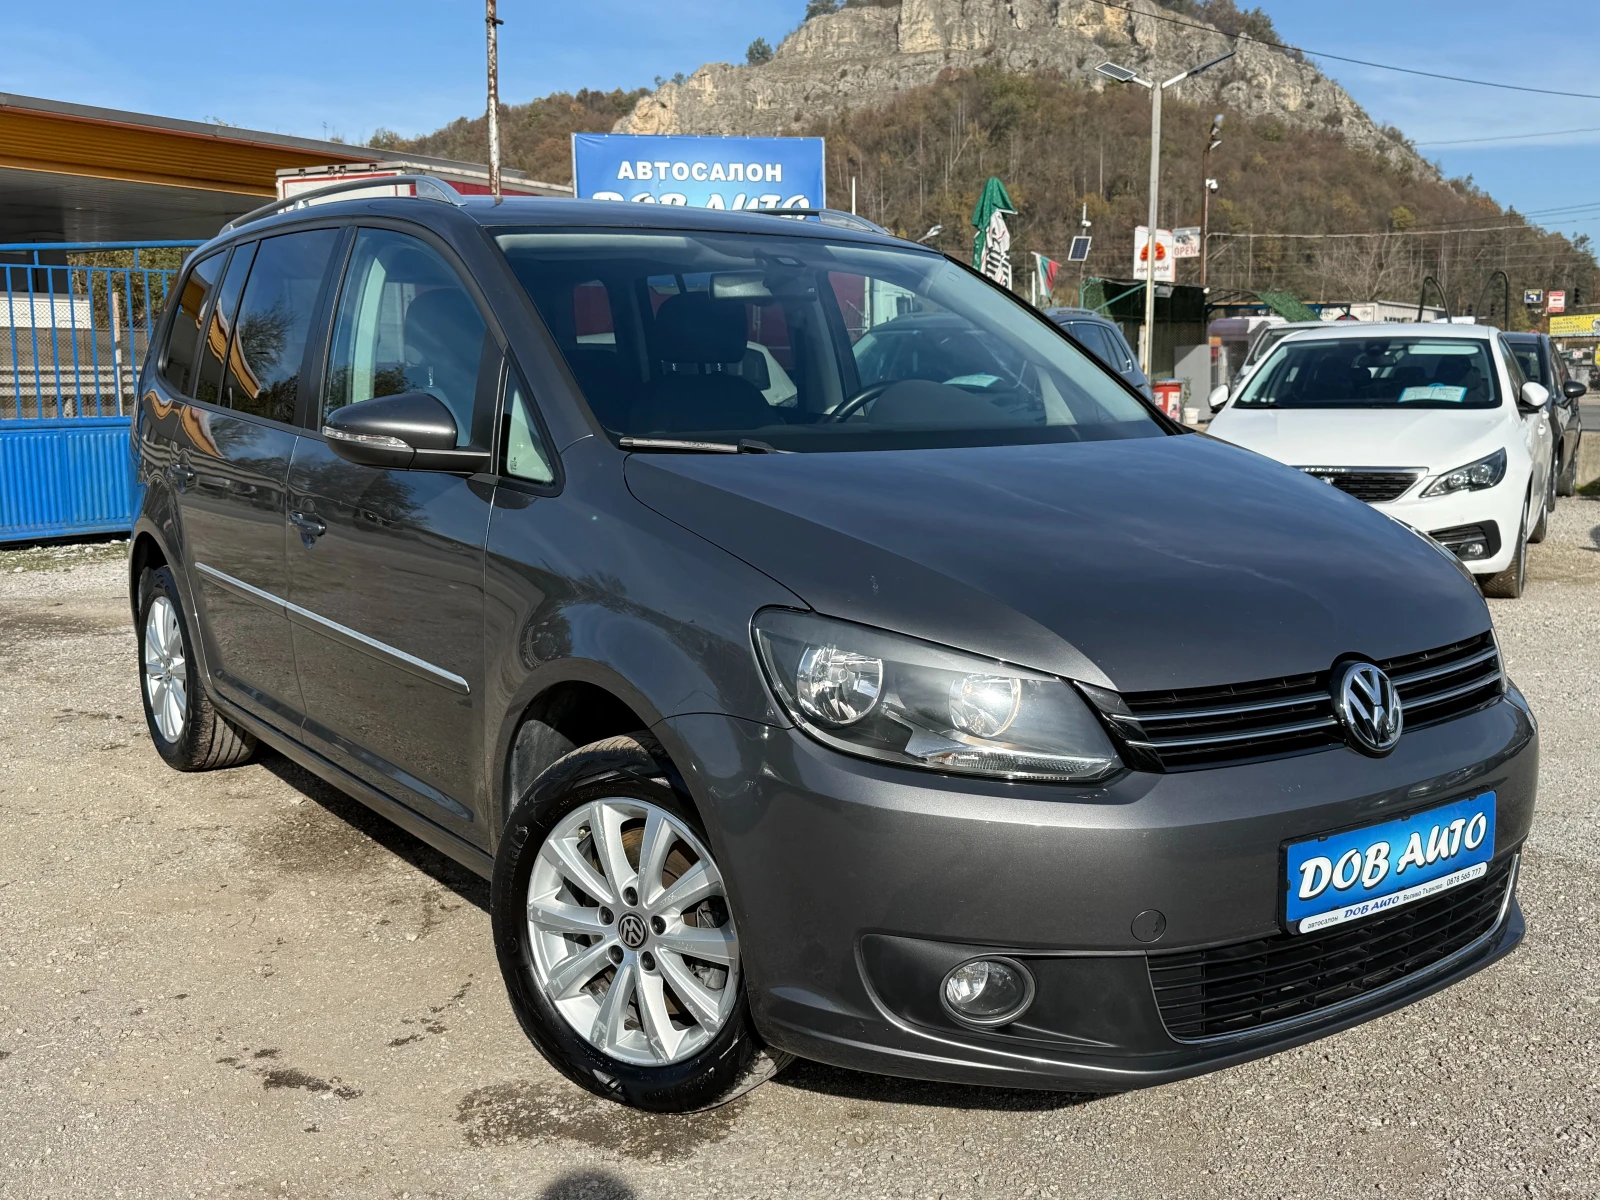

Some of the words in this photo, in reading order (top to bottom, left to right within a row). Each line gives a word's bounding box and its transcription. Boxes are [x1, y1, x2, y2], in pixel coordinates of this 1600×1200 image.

[617, 161, 782, 182] АВТОСАЛОН
[1174, 246, 1197, 256] OPEN
[1299, 841, 1391, 900] DOB
[1397, 812, 1487, 874] AUTO
[1344, 904, 1369, 918] DOB
[1371, 895, 1400, 911] AUTO
[1446, 874, 1460, 886] 0878
[1471, 867, 1482, 877] 777
